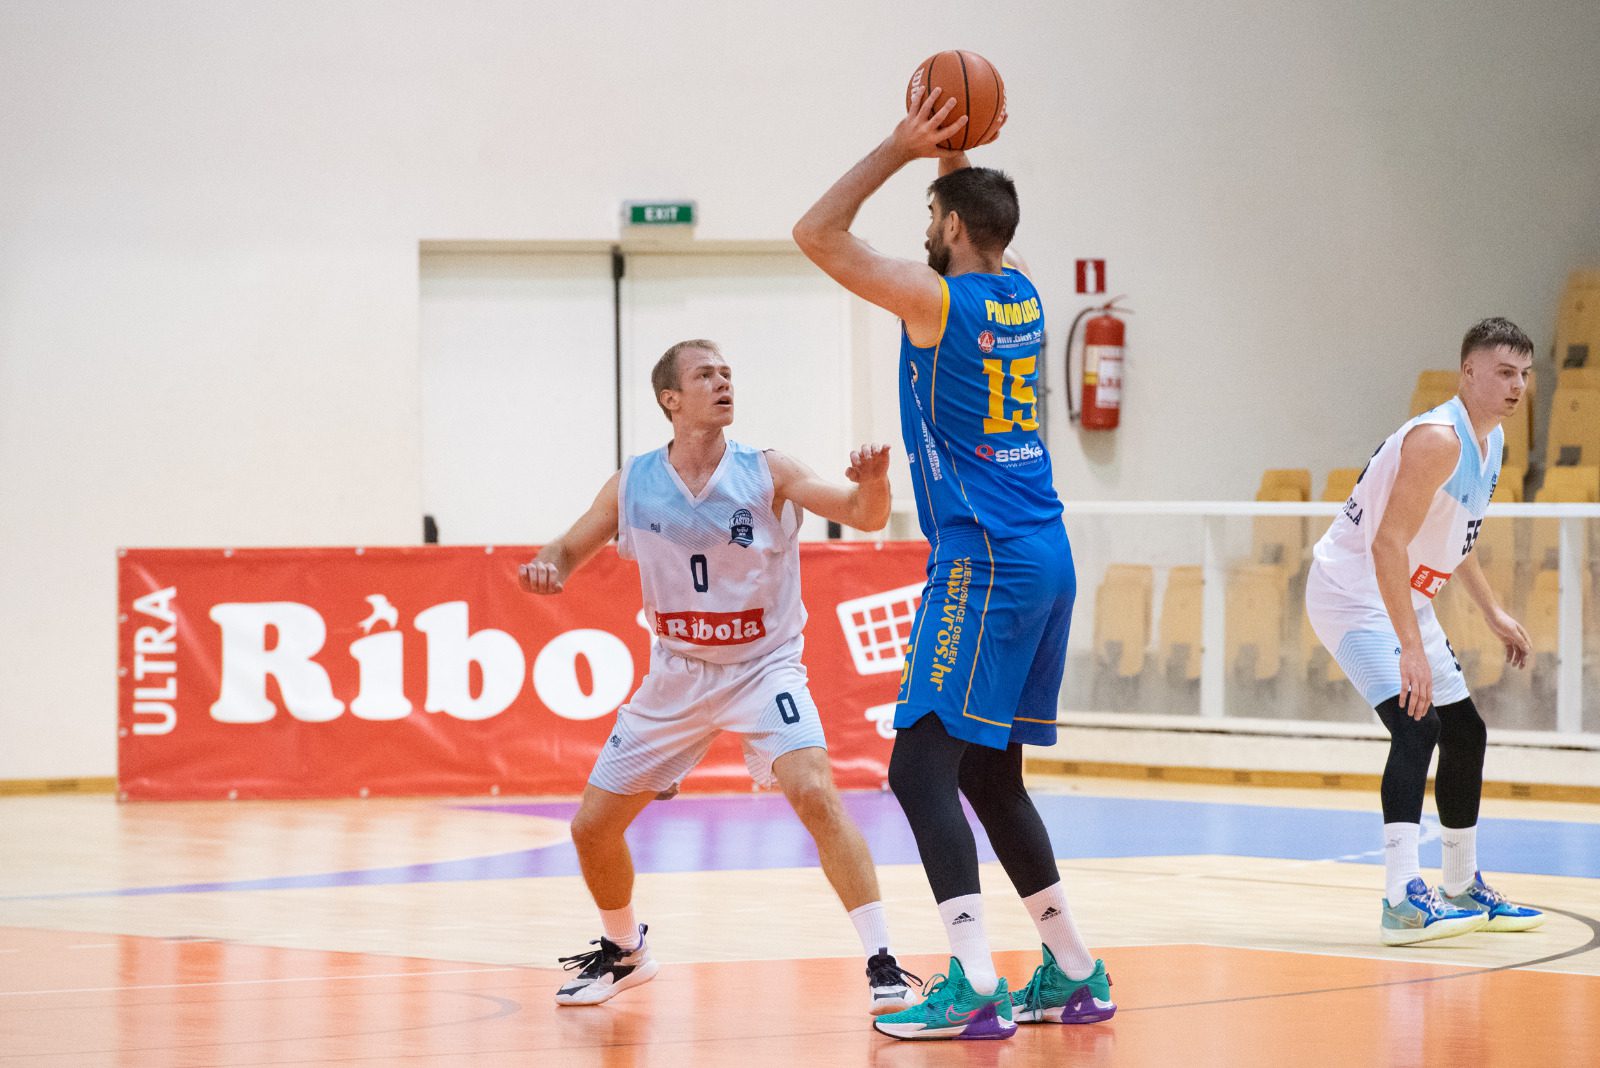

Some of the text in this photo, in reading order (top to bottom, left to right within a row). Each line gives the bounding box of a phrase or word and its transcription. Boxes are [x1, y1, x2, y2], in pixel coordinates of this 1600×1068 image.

[644, 206, 678, 221] EXIT
[982, 355, 1039, 434] 15
[1461, 519, 1483, 556] 55
[690, 554, 709, 593] 0
[666, 617, 761, 641] Ribola
[948, 626, 962, 665] OSIJEK
[133, 587, 177, 736] ULTRA
[209, 594, 651, 723] Ribo
[775, 692, 800, 725] 0
[951, 917, 975, 926] adidas
